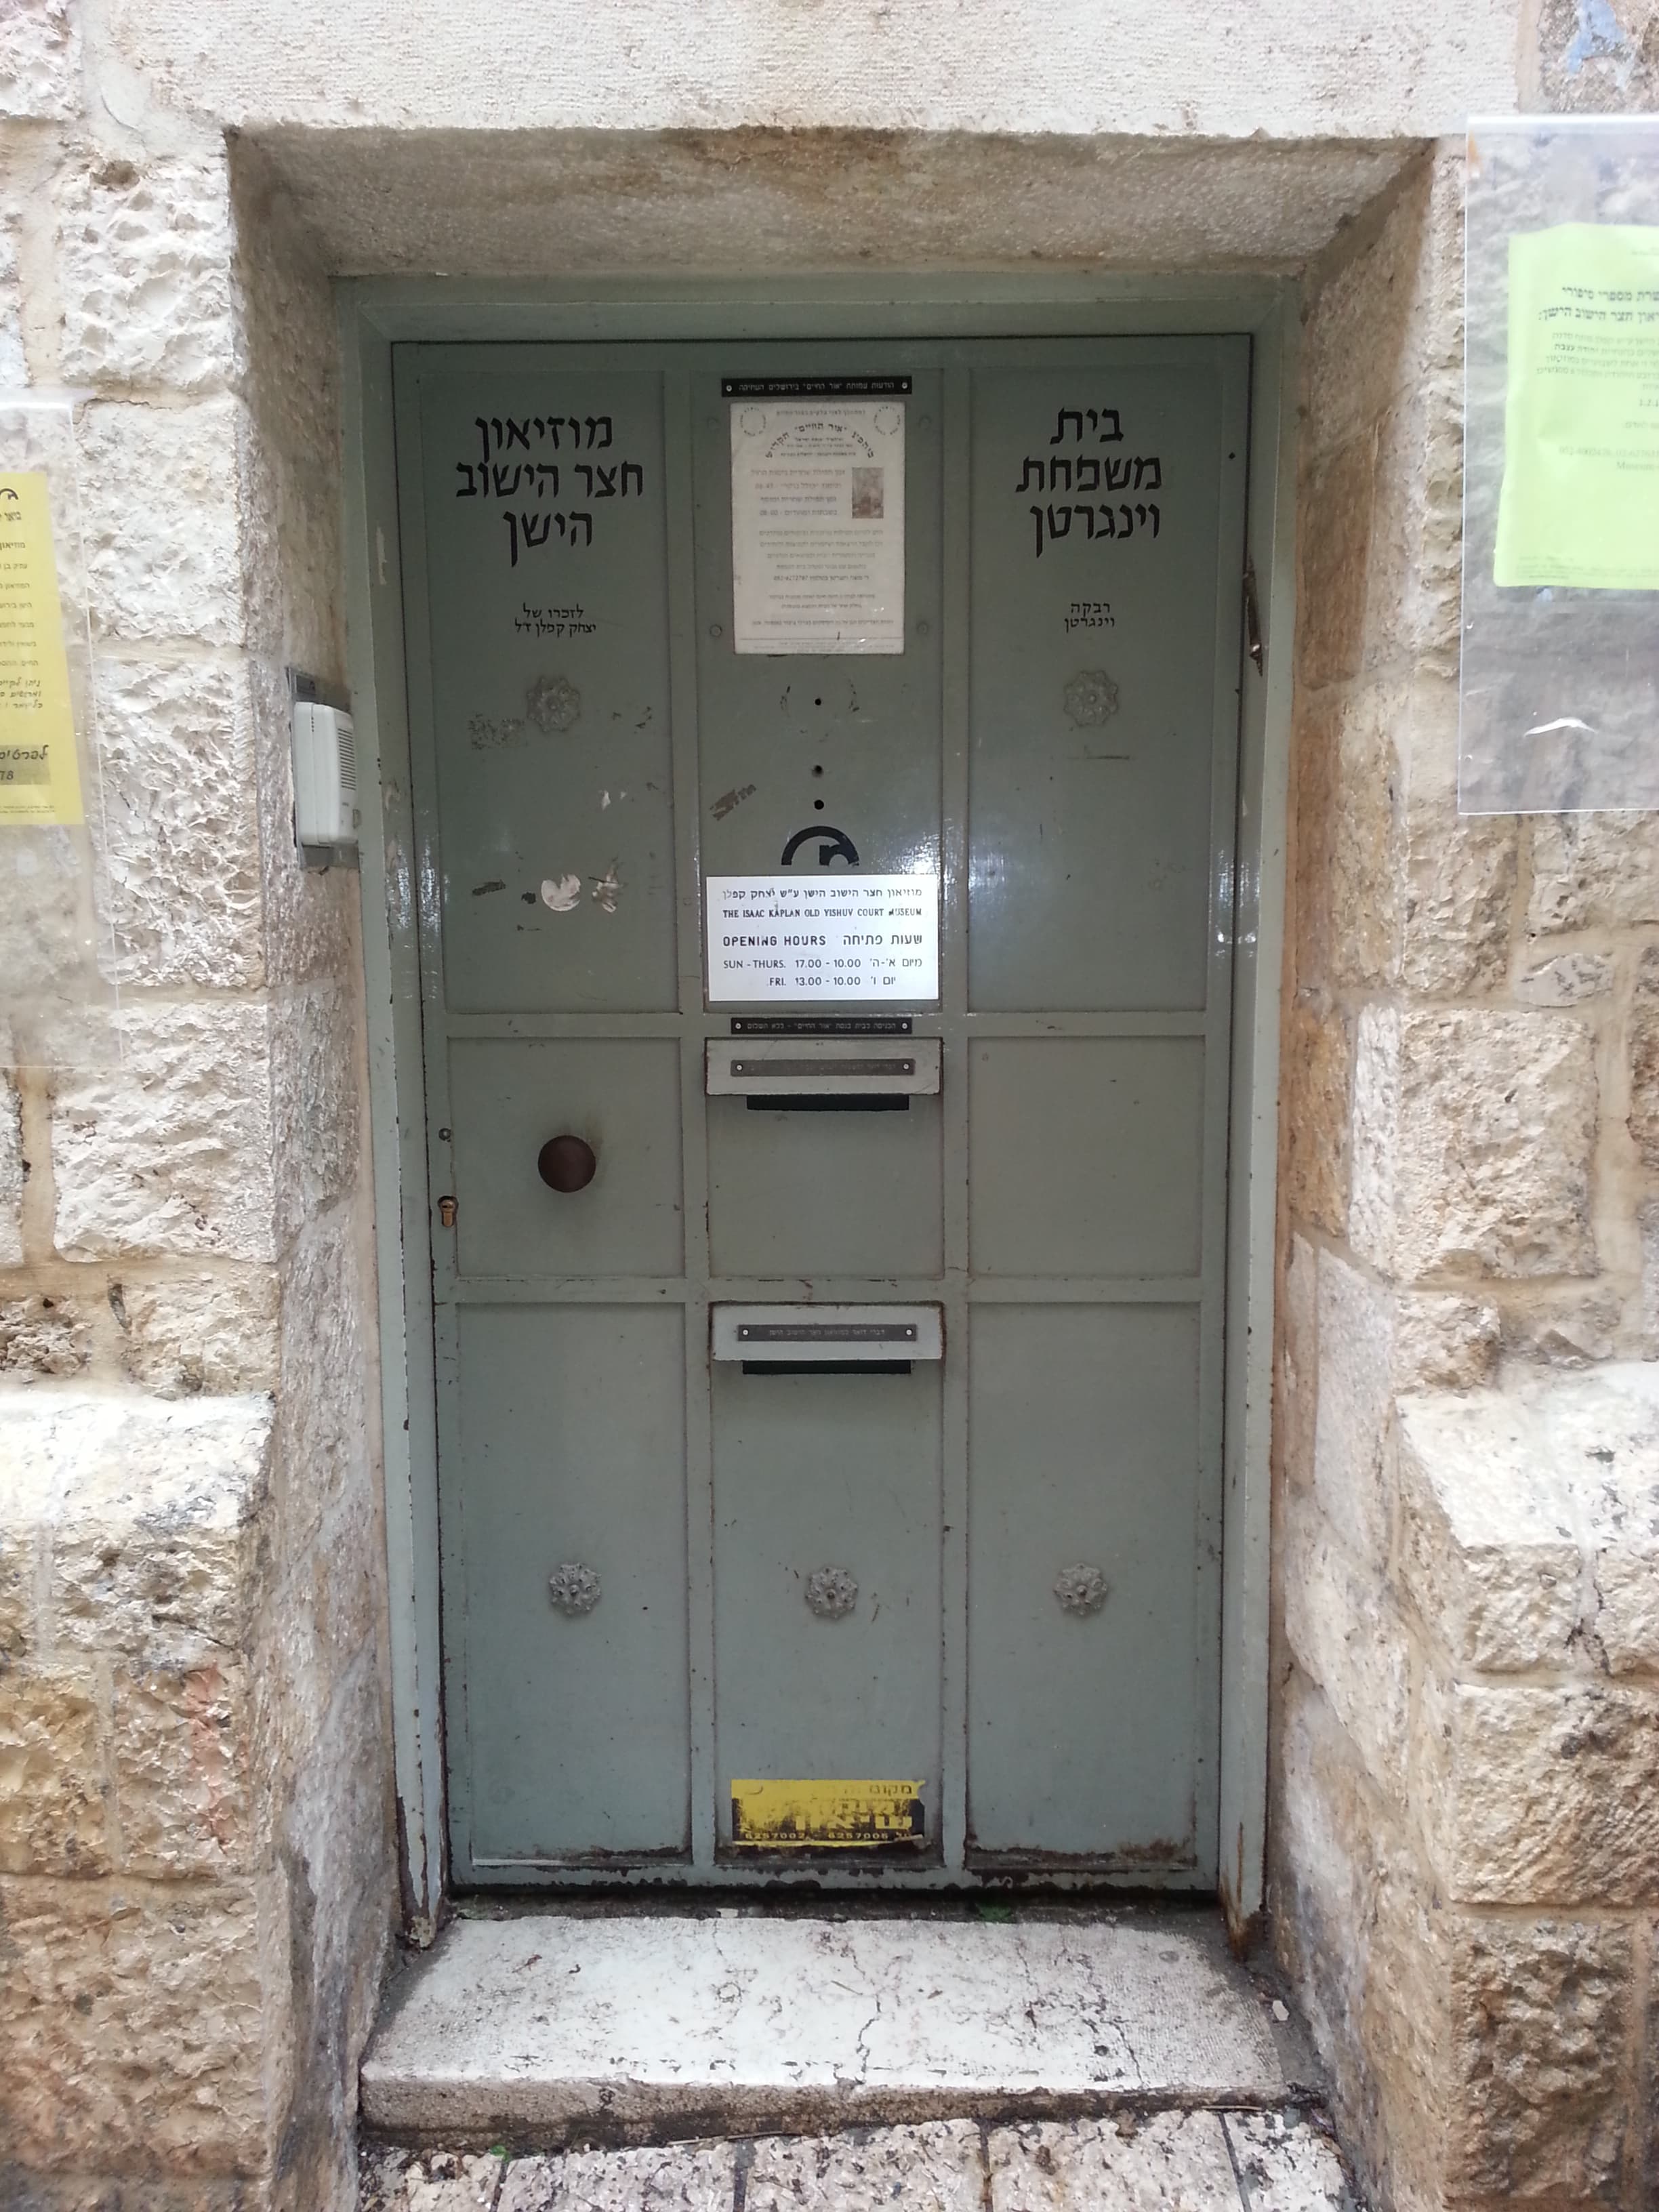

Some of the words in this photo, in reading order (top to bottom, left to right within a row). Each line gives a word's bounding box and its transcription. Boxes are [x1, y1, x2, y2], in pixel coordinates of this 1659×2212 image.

[1050, 407, 1124, 445] בית
[475, 415, 613, 464] מוזיאון
[574, 460, 644, 498] חצר
[1015, 455, 1162, 492] משפחת
[455, 462, 560, 498] הישוב
[1030, 504, 1160, 558] וינגרטן
[502, 511, 593, 568] הישן
[523, 602, 543, 618] של
[548, 604, 584, 618] לזכרו
[1071, 602, 1111, 618] רבקה
[535, 618, 565, 638] קפלן
[569, 622, 596, 638] יצחק
[1064, 617, 1115, 634] וינגרטן
[722, 889, 746, 900] קפלן
[750, 889, 776, 900] יצחק
[779, 889, 800, 898] ע"ש
[803, 890, 826, 899] הישן
[830, 889, 859, 898] הישוב
[863, 889, 883, 897] חצר
[887, 889, 922, 898] מוזיאון
[722, 909, 739, 918] THE
[743, 909, 765, 918] ISAAC
[769, 909, 800, 918] KAPLAN
[804, 909, 821, 917] OLD
[824, 909, 854, 917] YISHUV
[857, 908, 884, 917] COURT
[888, 908, 922, 916] MUSEUM
[723, 936, 778, 947] OPENING
[784, 935, 827, 946] HOURS
[843, 935, 883, 946] פתיחה
[890, 935, 923, 945] שעות
[723, 960, 743, 969] SUN
[753, 959, 787, 968] THURS.
[795, 959, 822, 968] 17.00
[833, 958, 862, 968] 10.00
[902, 958, 922, 967] מיום
[795, 977, 822, 986] 13.00
[833, 976, 861, 985] 10.00
[882, 976, 897, 985] יום
